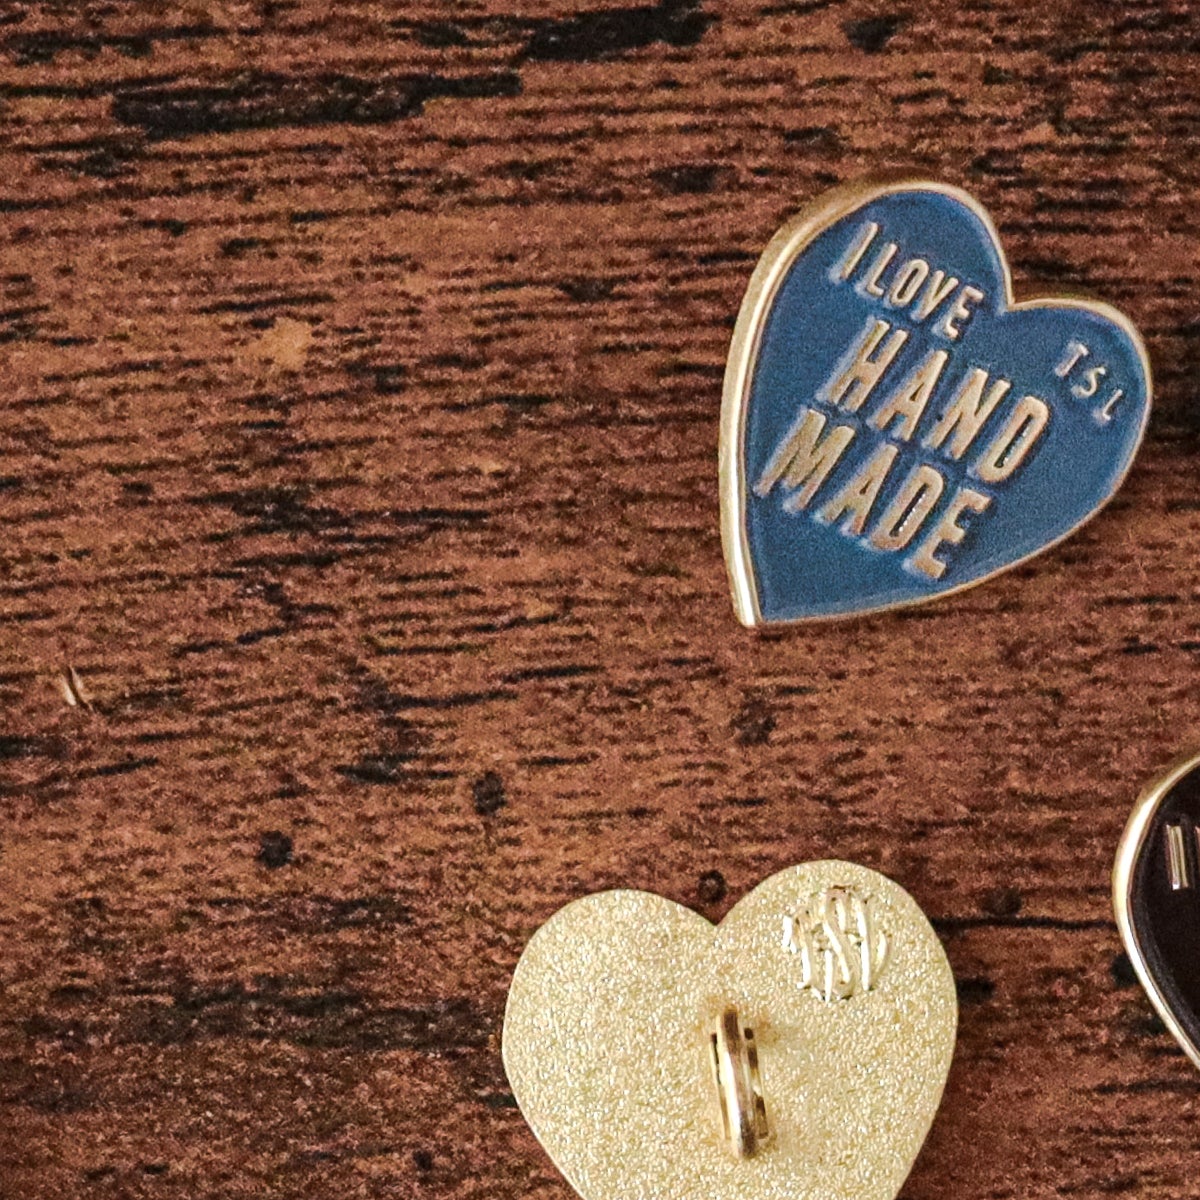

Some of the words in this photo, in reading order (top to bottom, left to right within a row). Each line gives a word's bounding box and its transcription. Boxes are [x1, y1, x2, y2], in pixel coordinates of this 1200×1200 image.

[830, 221, 879, 284] I
[856, 242, 984, 339] LOVE
[818, 319, 1052, 483] HAND
[754, 408, 992, 579] MADE
[1166, 824, 1189, 890] I
